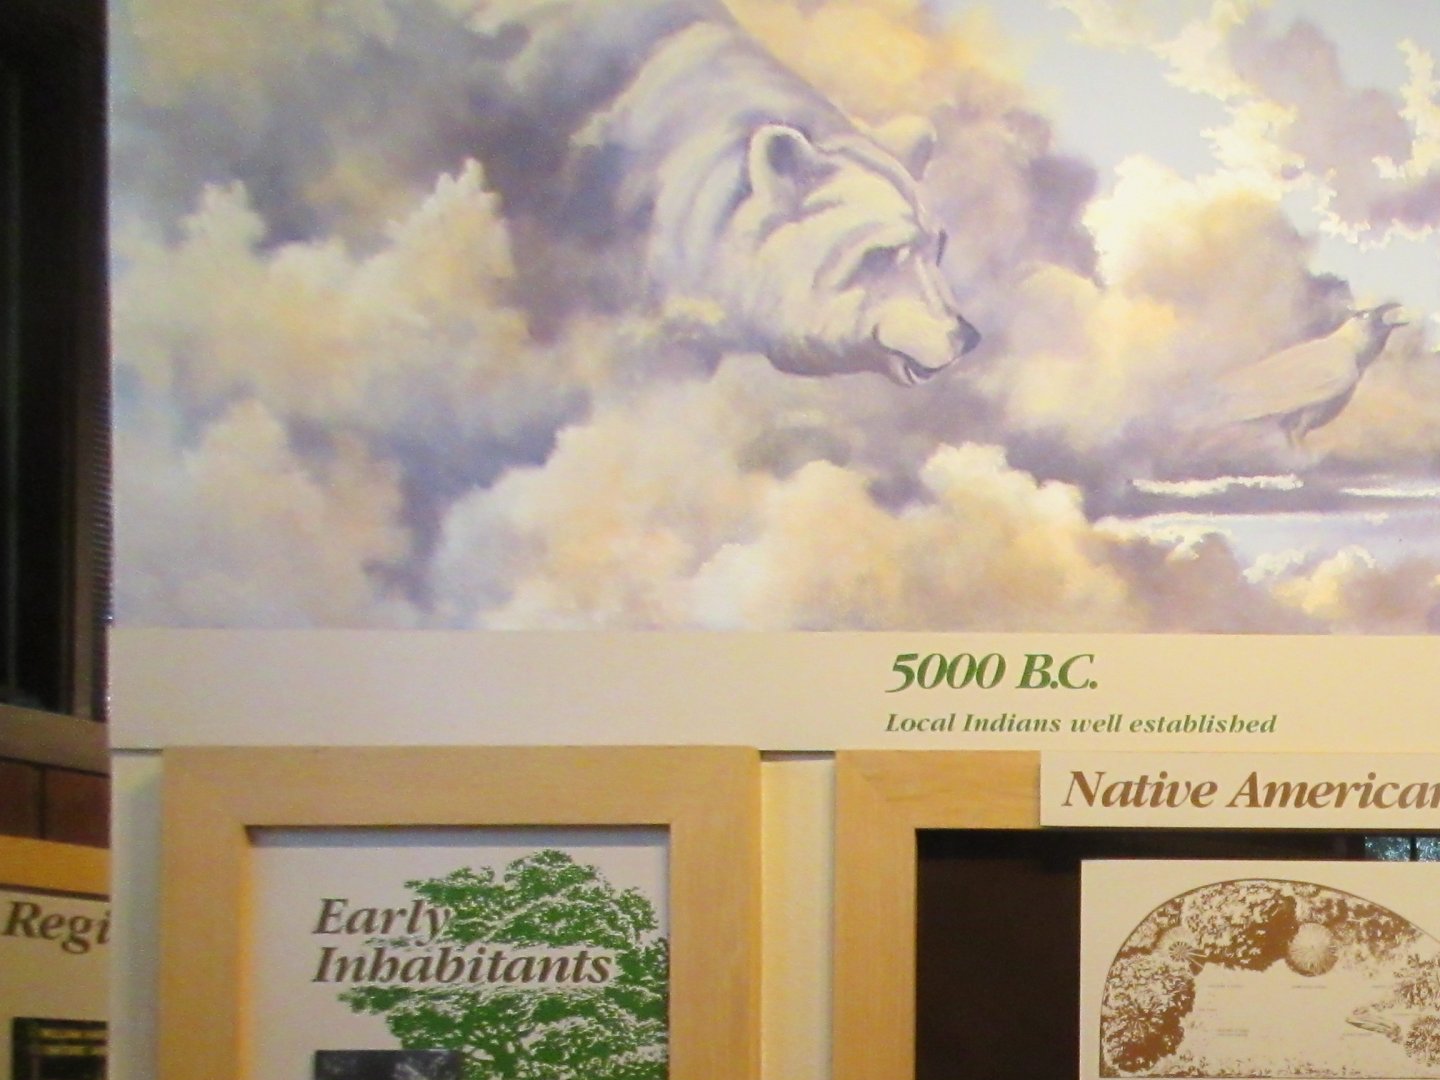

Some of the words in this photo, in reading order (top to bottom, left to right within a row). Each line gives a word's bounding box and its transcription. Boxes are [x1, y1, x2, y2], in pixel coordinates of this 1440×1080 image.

[884, 652, 1006, 693] 5000
[1016, 652, 1099, 691] B.C.
[884, 712, 955, 734] Local
[962, 712, 1061, 734] Indians
[1070, 712, 1123, 734] well
[1129, 713, 1277, 735] established
[1061, 770, 1217, 809] Native
[312, 898, 452, 946] Early
[310, 946, 613, 984] Inhabitants
